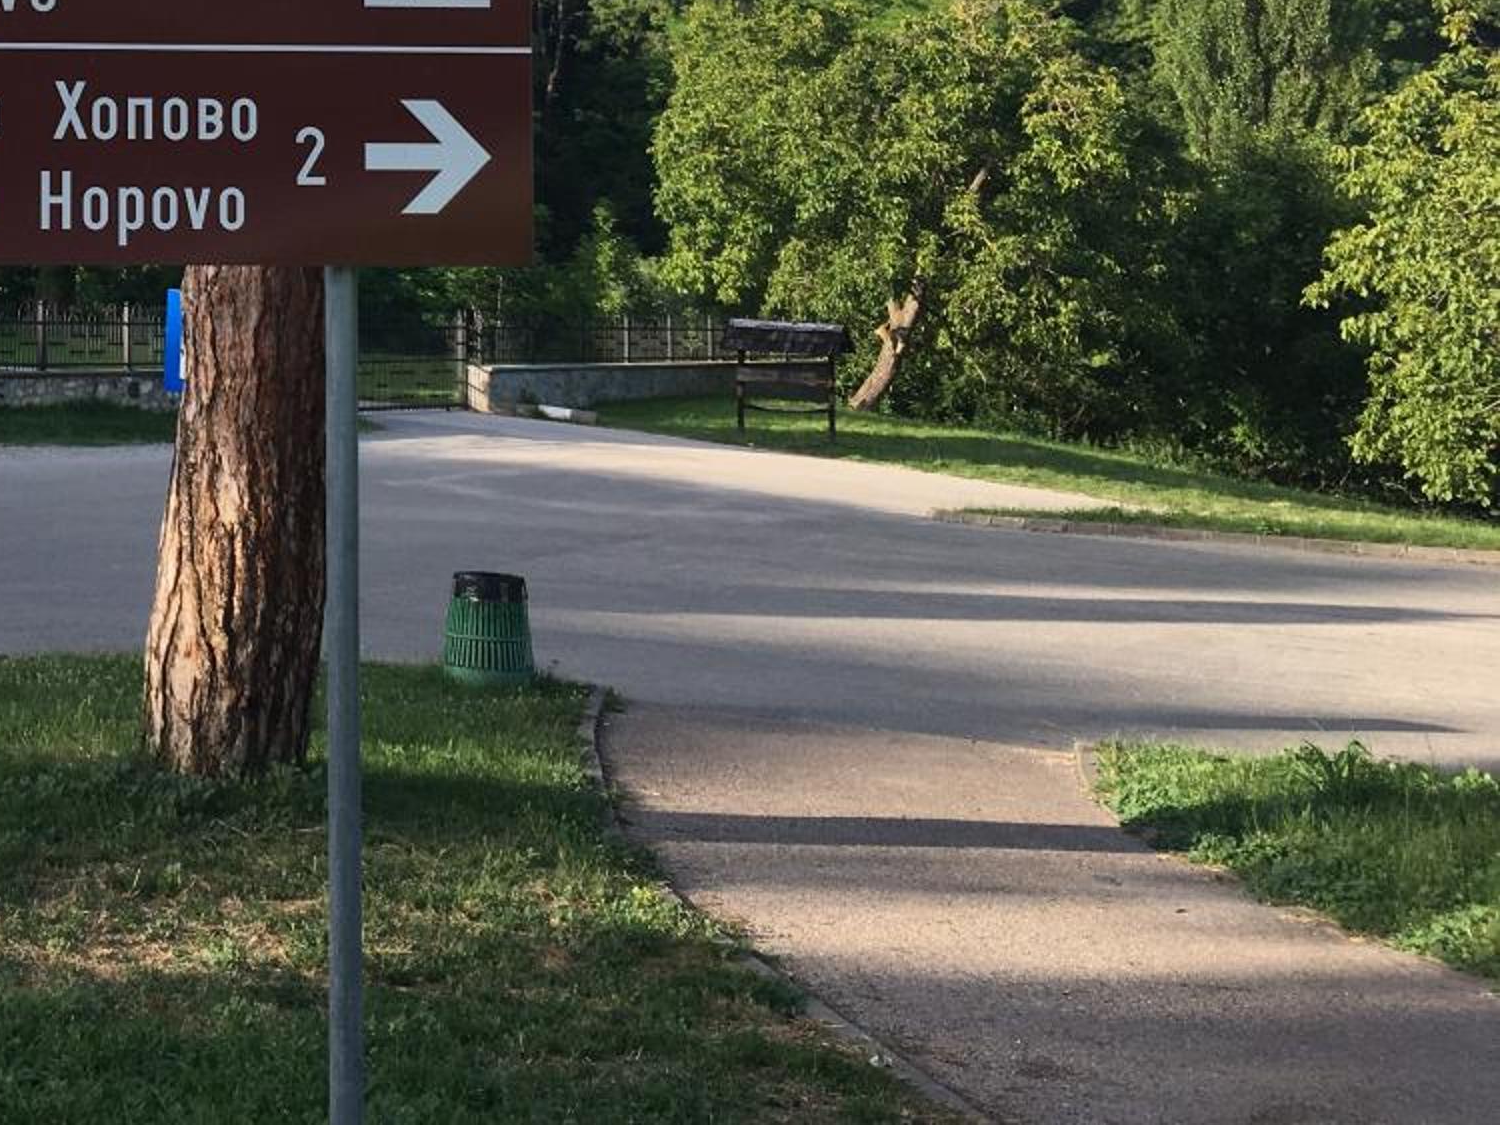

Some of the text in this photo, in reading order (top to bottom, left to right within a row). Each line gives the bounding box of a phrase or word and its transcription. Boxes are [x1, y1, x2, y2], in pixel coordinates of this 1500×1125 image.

[53, 80, 258, 142] Хопово
[295, 126, 327, 186] 2
[40, 170, 245, 247] Hopovo
